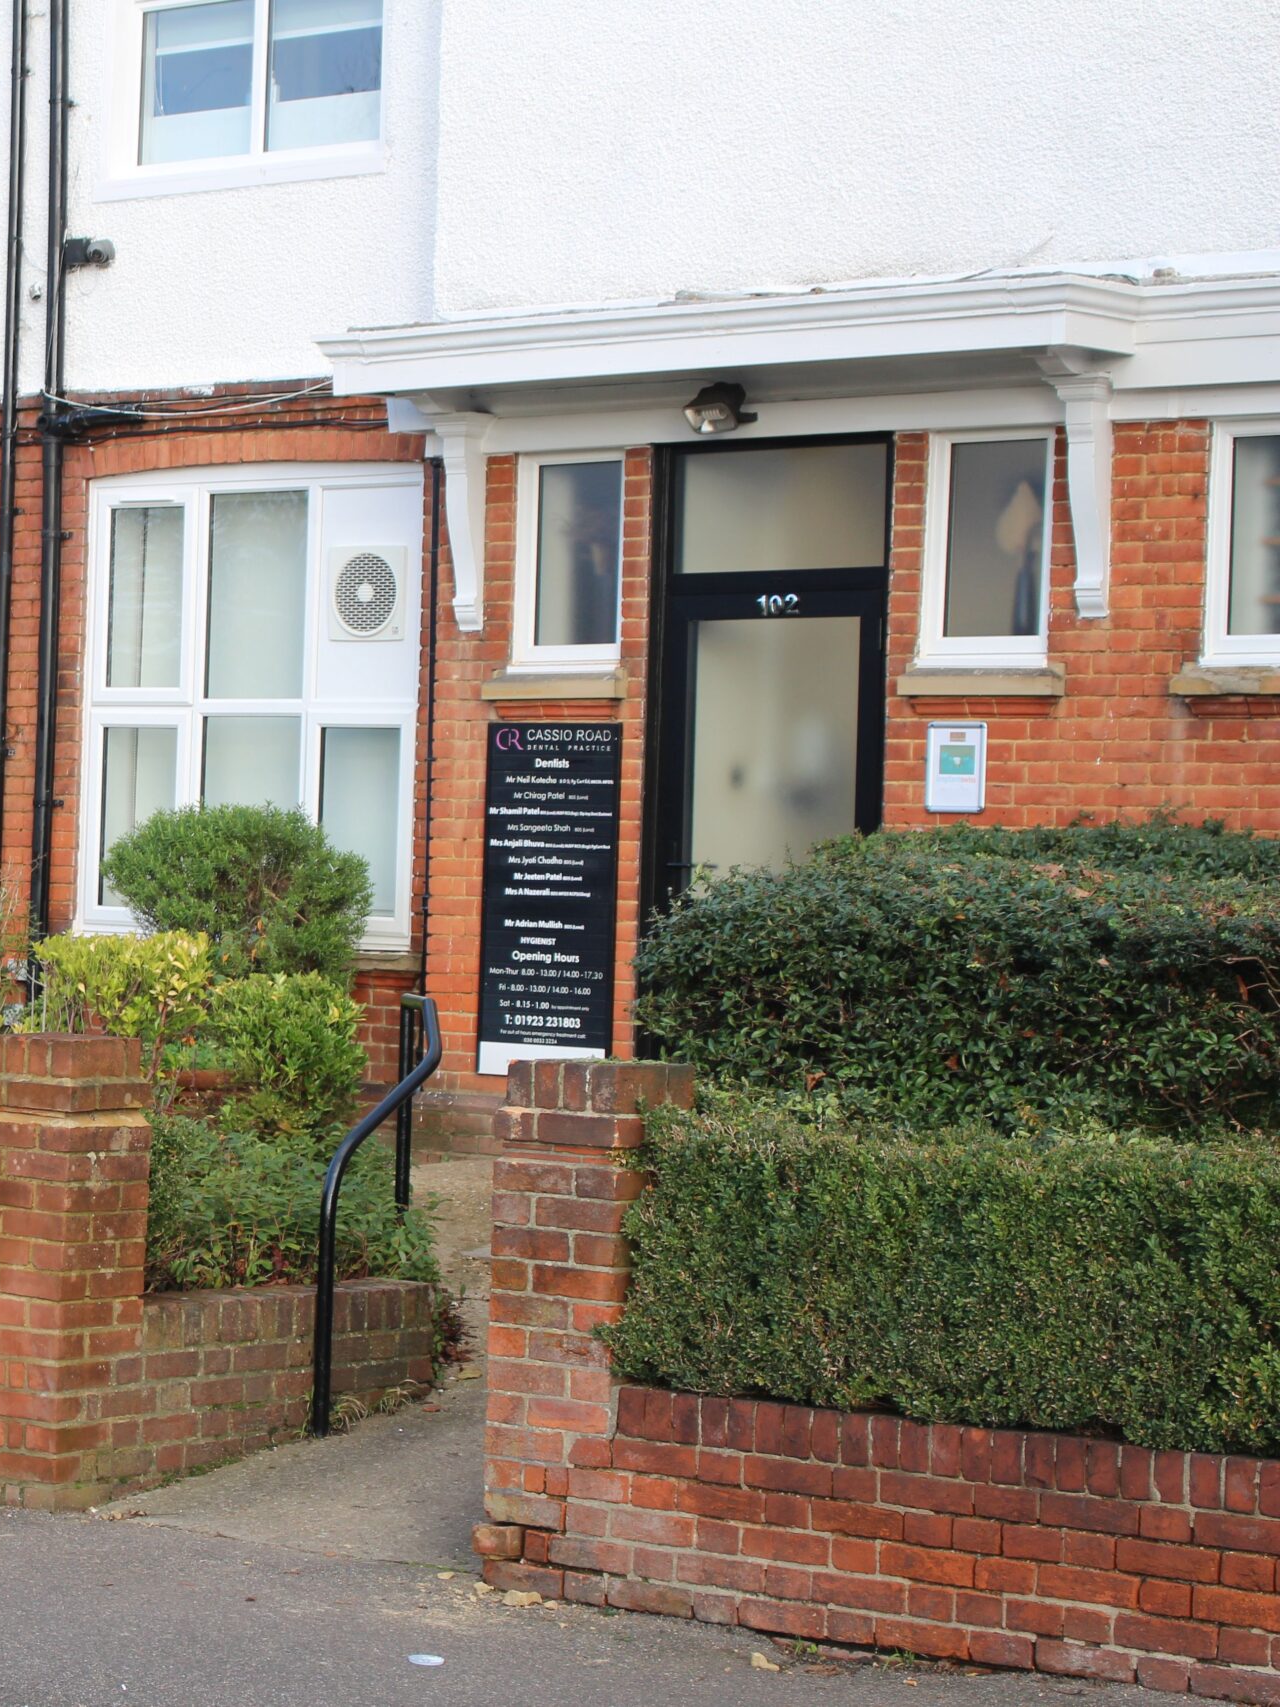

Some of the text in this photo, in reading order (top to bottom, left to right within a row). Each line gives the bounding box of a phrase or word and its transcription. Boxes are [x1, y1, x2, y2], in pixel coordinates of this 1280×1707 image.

[756, 593, 800, 616] 102
[496, 728, 524, 750] CR
[527, 729, 612, 741] CASSIO ROAD
[535, 758, 569, 768] Dentists
[517, 776, 530, 784] Neil
[531, 776, 557, 784] Kotecha
[524, 792, 546, 800] Chirag
[548, 792, 565, 800] Patel
[500, 807, 522, 815] Shamil
[523, 807, 540, 815] Patel
[520, 824, 552, 832] Sangeeta
[504, 839, 522, 848] Anjali
[524, 840, 545, 848] Bhuva
[521, 856, 536, 866] Jyoti
[505, 888, 517, 896] Mrs
[515, 920, 538, 928] Adrian
[538, 920, 563, 929] Mullish
[520, 937, 556, 946] HYGIENIST
[512, 950, 580, 964] Opening Hours
[521, 968, 535, 976] 8.00
[540, 969, 557, 977] 13.00
[574, 987, 592, 995] 16.00
[505, 1014, 581, 1028] T: 01923 231803
